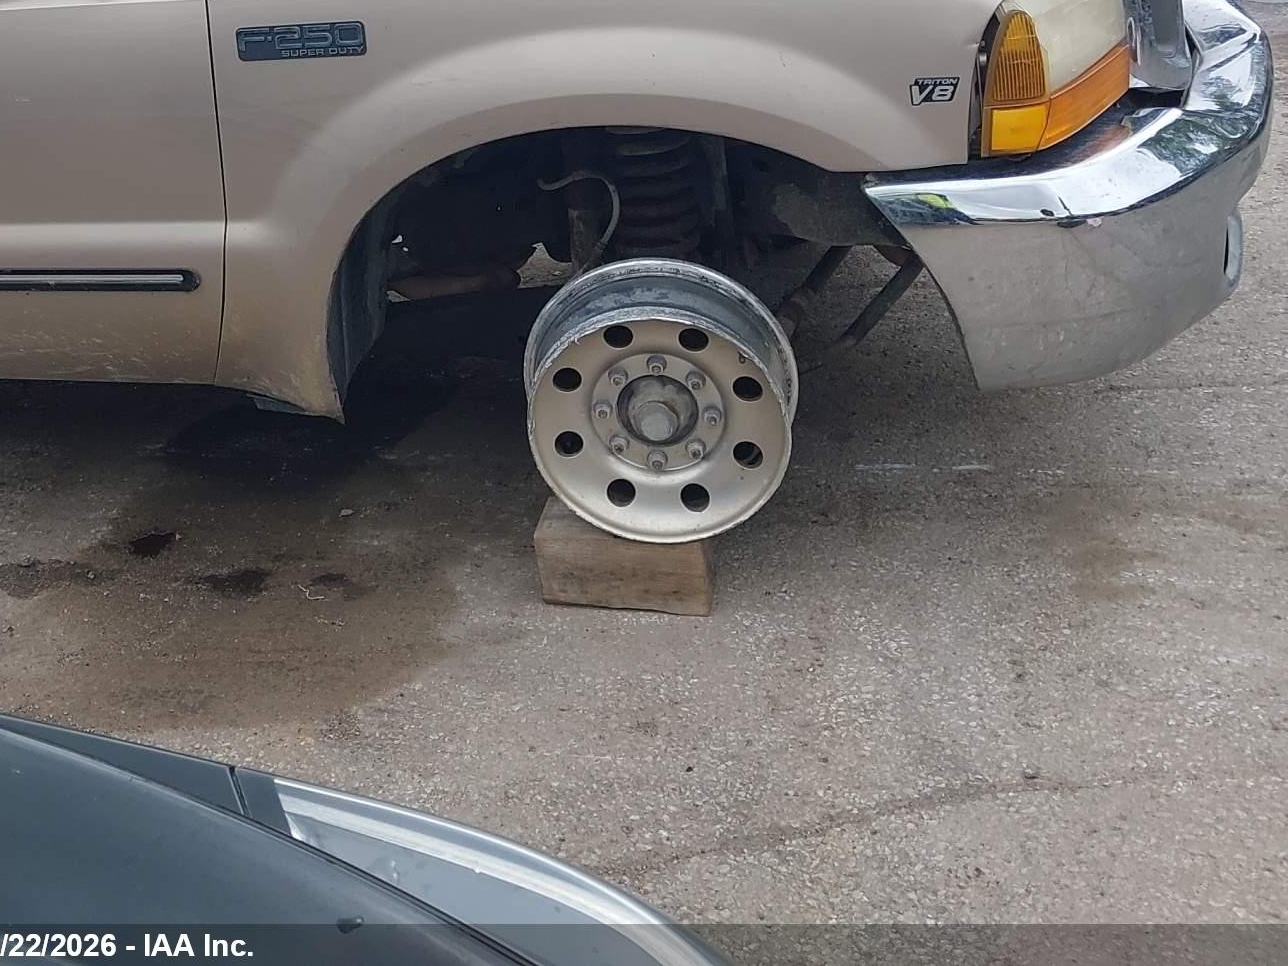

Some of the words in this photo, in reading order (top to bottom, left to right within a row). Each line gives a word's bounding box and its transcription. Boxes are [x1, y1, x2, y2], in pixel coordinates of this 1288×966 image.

[237, 22, 364, 52] F-250
[281, 48, 325, 58] SUPER
[328, 46, 364, 56] DUTY
[910, 84, 954, 105] V8
